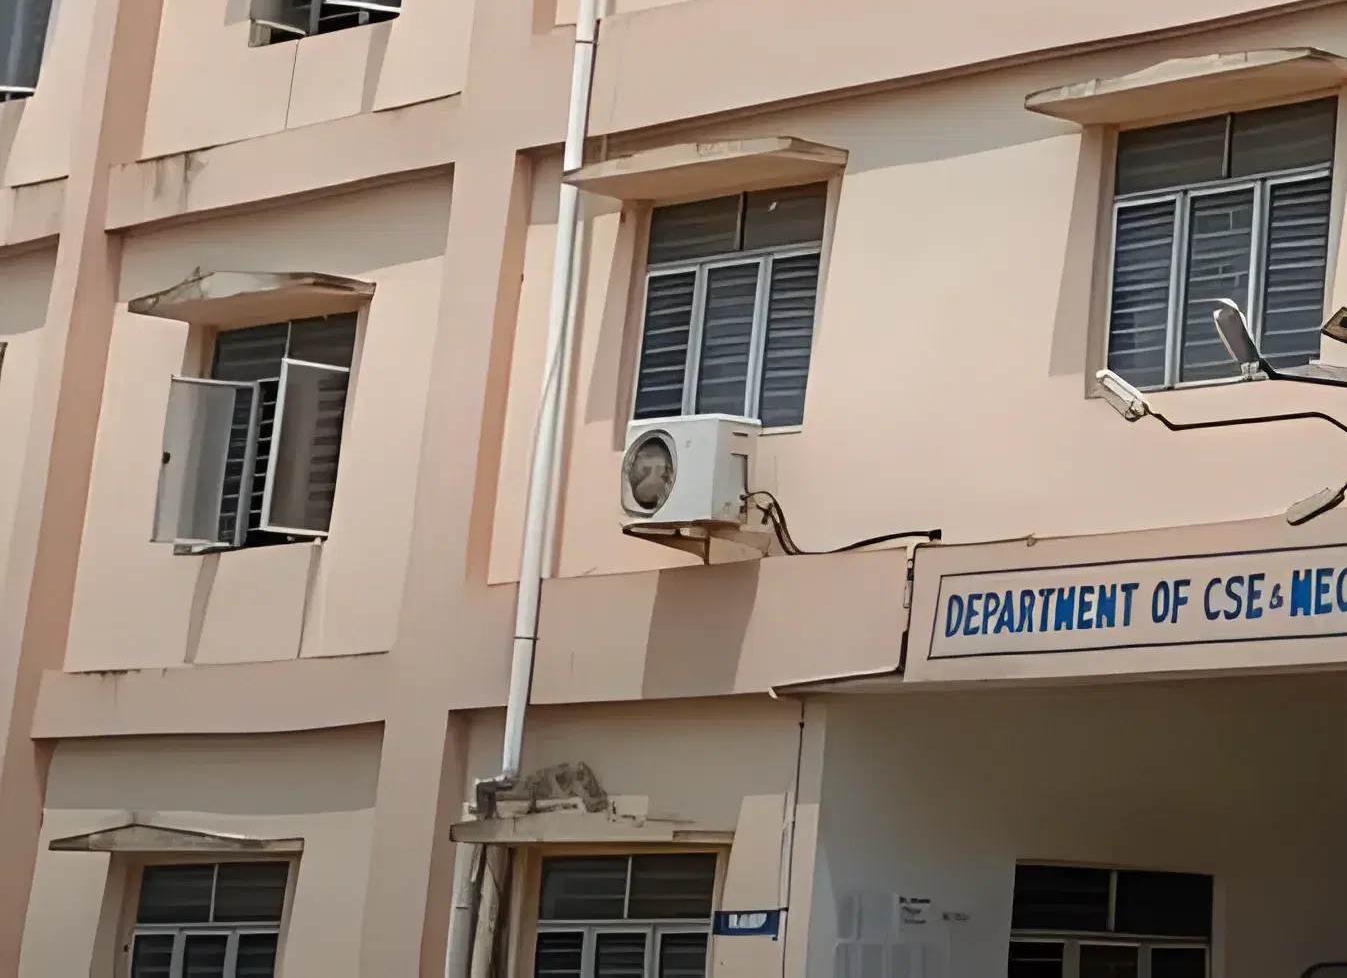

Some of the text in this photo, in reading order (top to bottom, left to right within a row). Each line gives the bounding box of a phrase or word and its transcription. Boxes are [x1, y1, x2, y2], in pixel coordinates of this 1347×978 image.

[945, 582, 1140, 637] DEPARTMENT
[1151, 579, 1191, 624] OF
[1204, 573, 1265, 621] CSE
